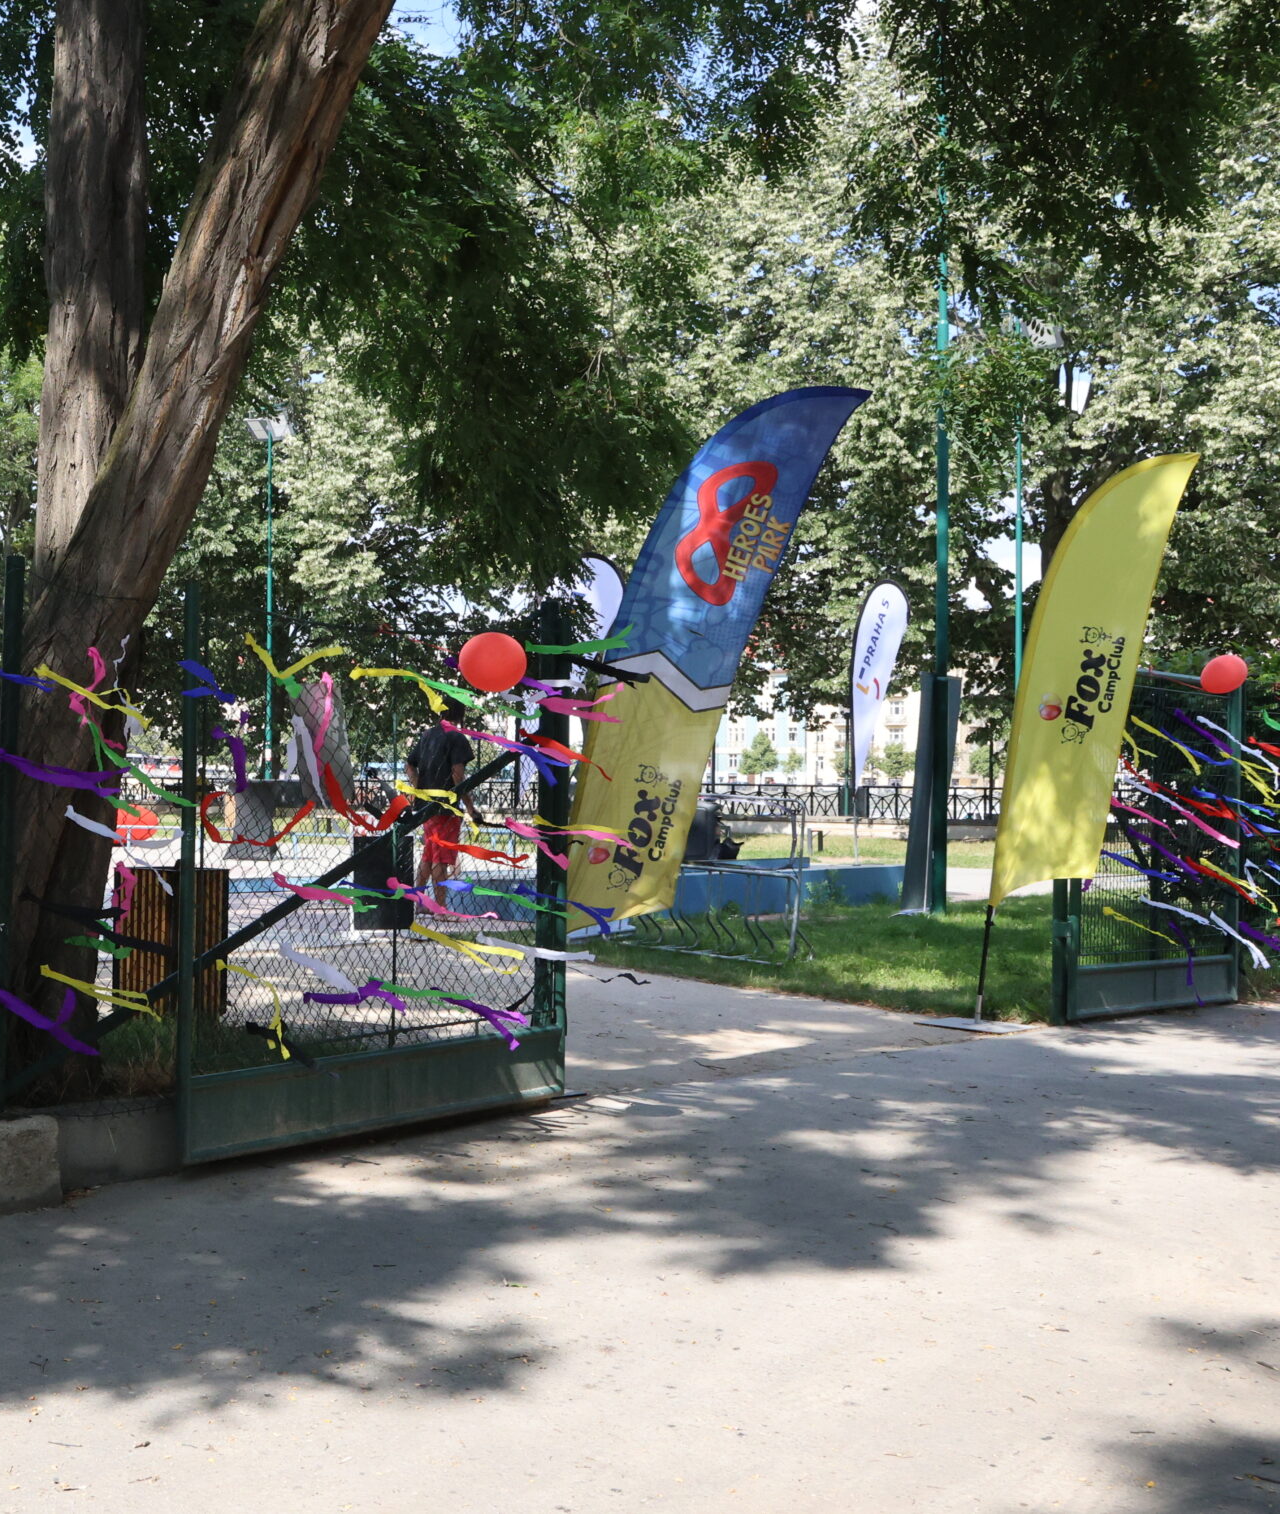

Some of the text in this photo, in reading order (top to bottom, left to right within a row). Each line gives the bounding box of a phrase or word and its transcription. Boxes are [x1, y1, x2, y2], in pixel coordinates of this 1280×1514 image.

[722, 493, 772, 581] HEROES
[752, 516, 791, 573] PARK
[863, 598, 889, 667] PRAHA 5
[1098, 636, 1126, 713] CampClub
[648, 780, 682, 861] CampClub
